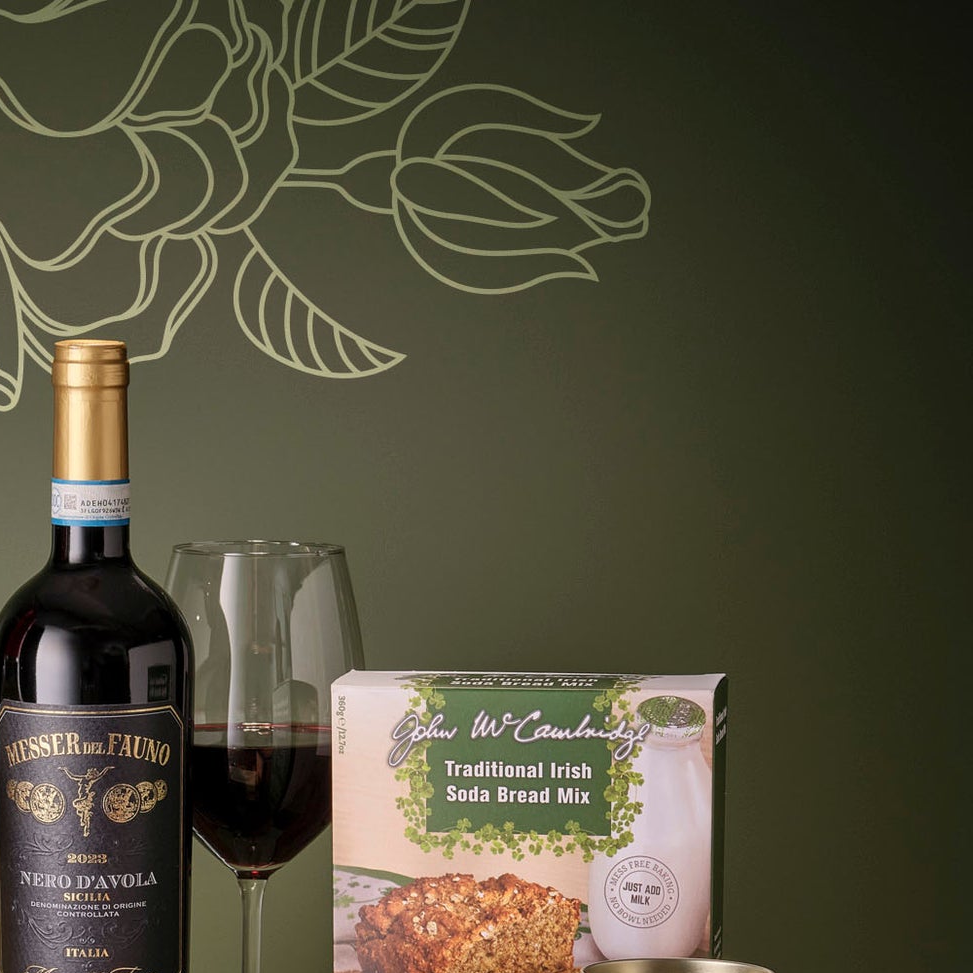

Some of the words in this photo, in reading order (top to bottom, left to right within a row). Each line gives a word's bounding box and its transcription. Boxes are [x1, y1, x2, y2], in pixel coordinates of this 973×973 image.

[336, 695, 346, 717] 360g
[388, 712, 458, 767] John
[5, 732, 83, 767] MESSER
[83, 741, 105, 755] DEL
[106, 732, 170, 767] FAUNO
[444, 760, 543, 778] Traditional
[551, 762, 593, 779] Irish
[446, 785, 490, 802] Soda
[497, 786, 550, 804] Bread
[557, 787, 590, 804] Mix
[67, 853, 108, 864] 2023
[20, 870, 71, 889] NERO
[76, 871, 158, 889] D'AVOLA
[610, 864, 628, 886] MESS
[628, 860, 651, 869] FREE
[652, 864, 675, 894] BAKING
[63, 892, 111, 901] SICILIA
[622, 882, 642, 892] JUST
[645, 885, 661, 896] ADD
[30, 901, 100, 910] DENOMINAZIONE
[113, 901, 147, 909] ORIGINE
[630, 894, 650, 906] MILK
[610, 896, 620, 909] NO
[617, 907, 642, 924] BOWL
[642, 904, 671, 925] NEEDED
[65, 947, 109, 957] ITALIA
